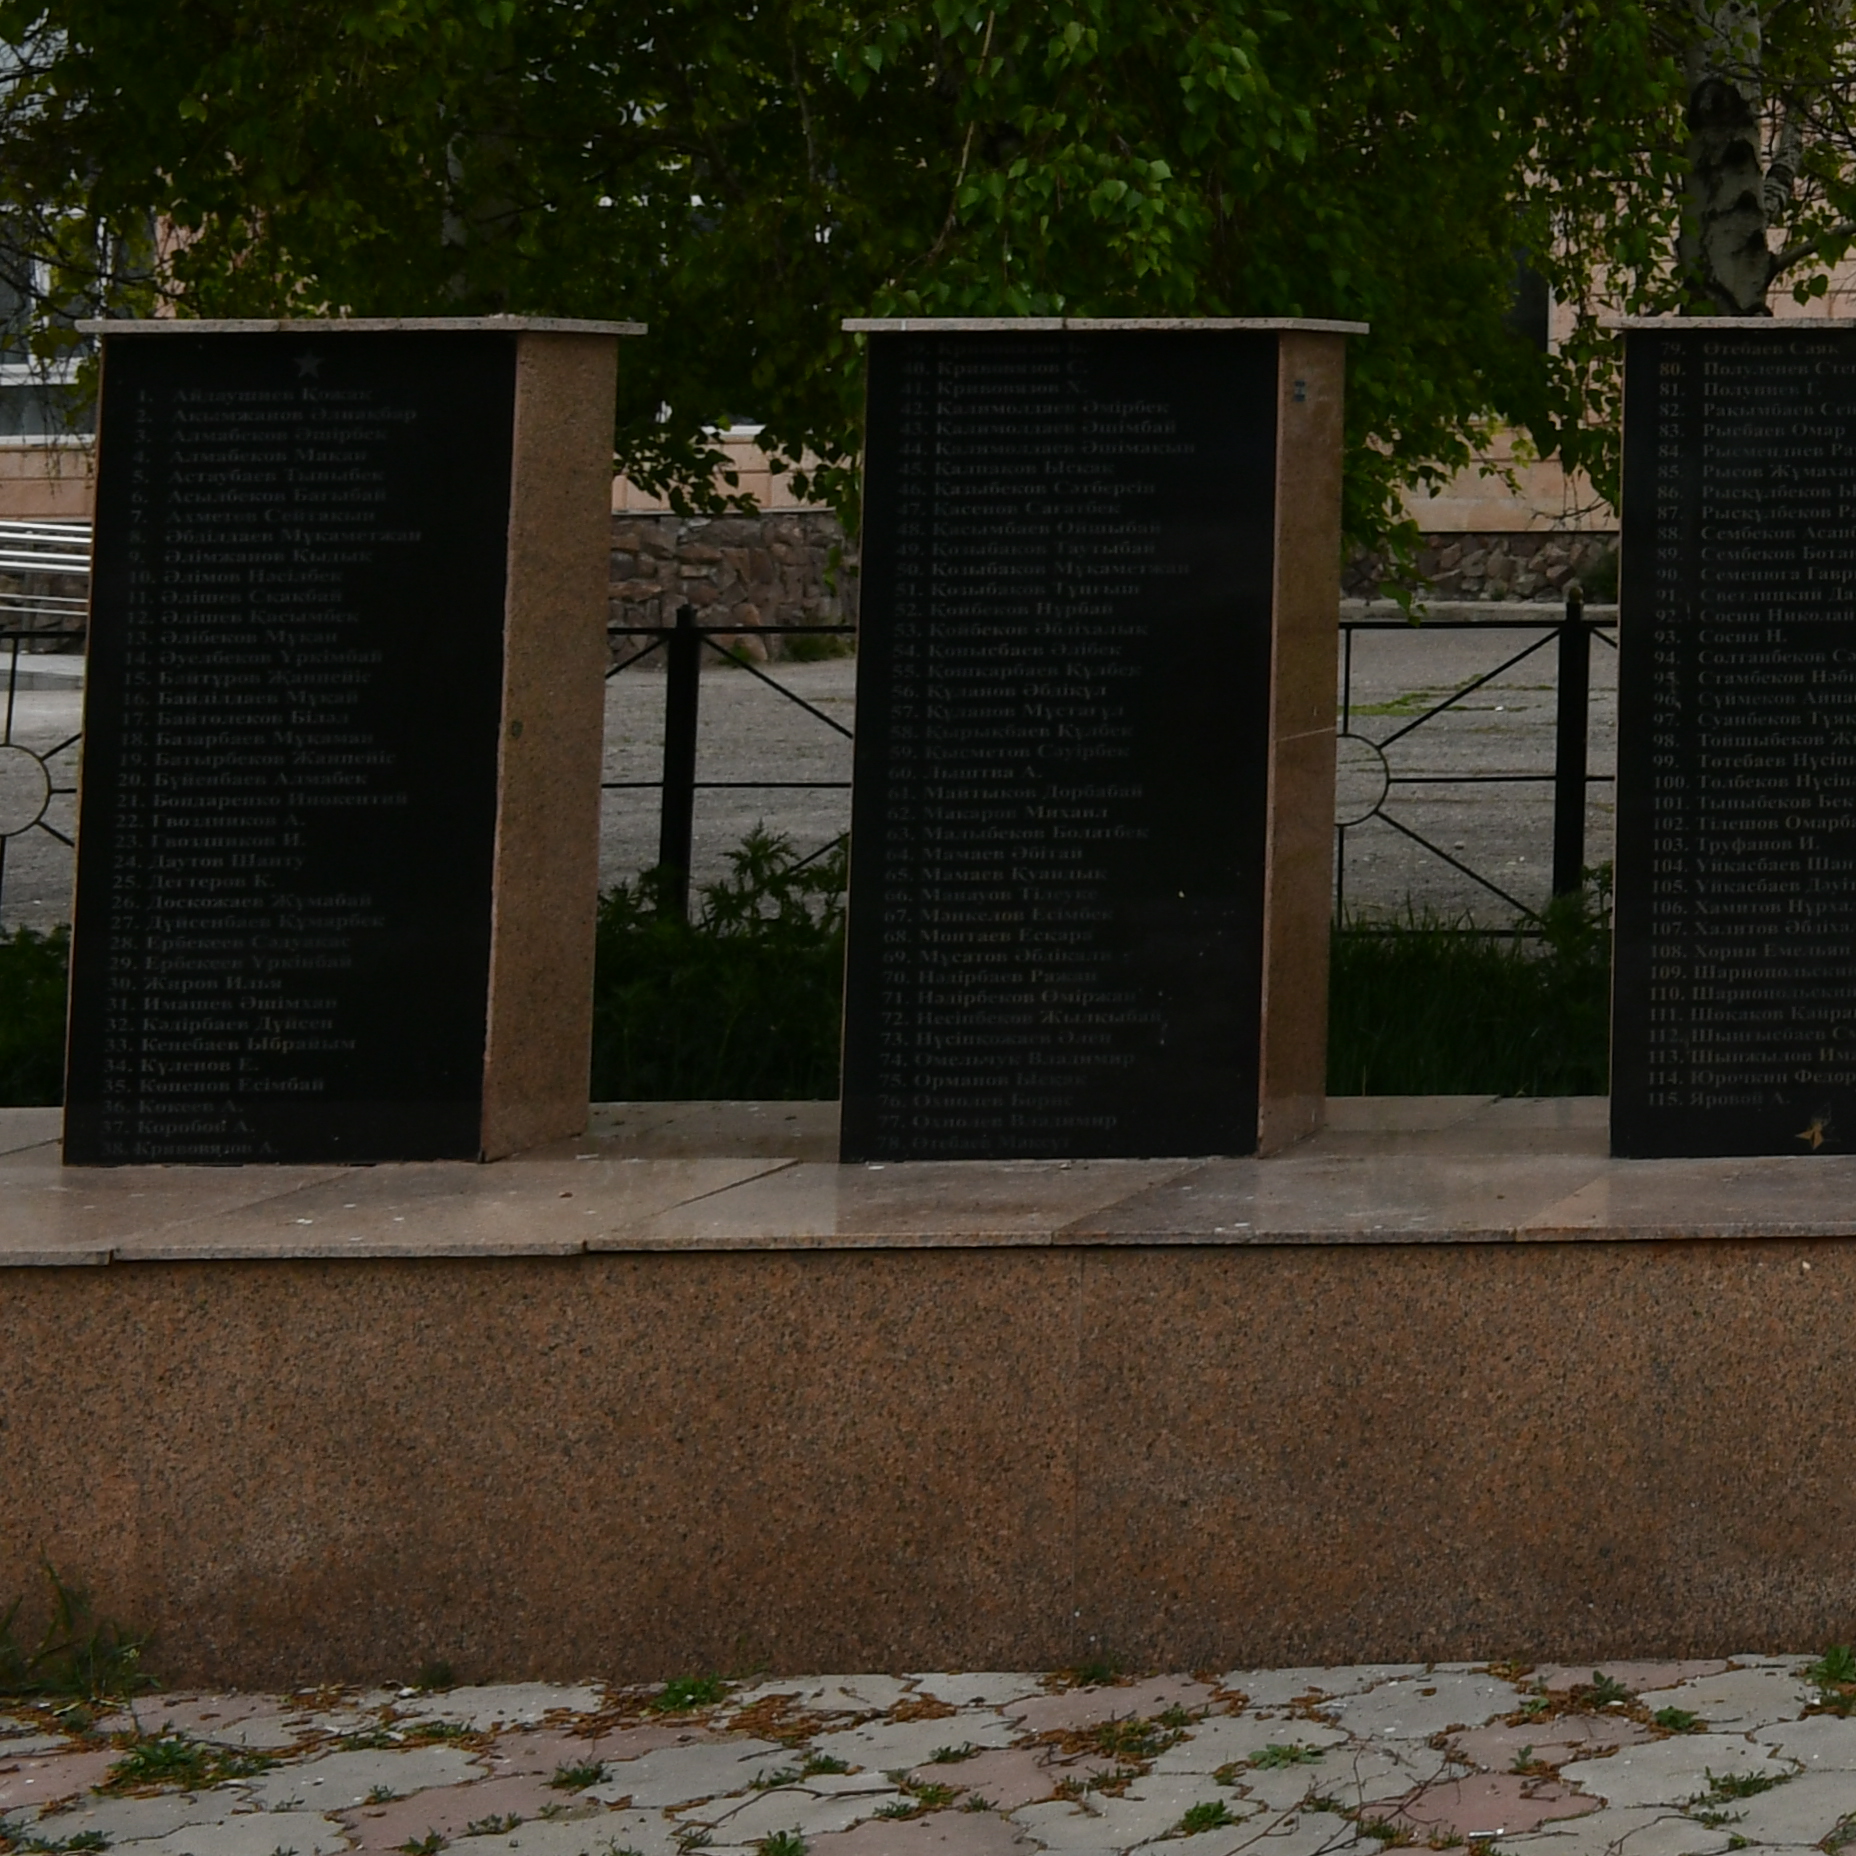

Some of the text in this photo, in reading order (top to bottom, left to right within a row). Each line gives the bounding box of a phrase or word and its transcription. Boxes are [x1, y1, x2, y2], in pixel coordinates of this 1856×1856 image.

[134, 429, 152, 443] 3.
[1659, 424, 1684, 438] 83.
[1658, 527, 1683, 540] 88.
[129, 570, 156, 584] 10.
[1656, 609, 1683, 622] 92.
[1654, 630, 1681, 644] 93.
[887, 806, 915, 820] 62.
[116, 814, 144, 828] 22.
[1654, 816, 1689, 831] 102.
[886, 827, 915, 840] 63.
[115, 834, 142, 848] 23.
[1654, 838, 1689, 852] 103.
[1651, 944, 1687, 958] 108.
[108, 977, 136, 991] 30.
[883, 970, 910, 984] 70.
[106, 997, 135, 1012] 31.
[882, 991, 909, 1004] 71.
[105, 1038, 133, 1052] 33.
[880, 1052, 907, 1067] 74.
[1649, 1070, 1683, 1085] 114.
[1649, 1092, 1682, 1106] 115.
